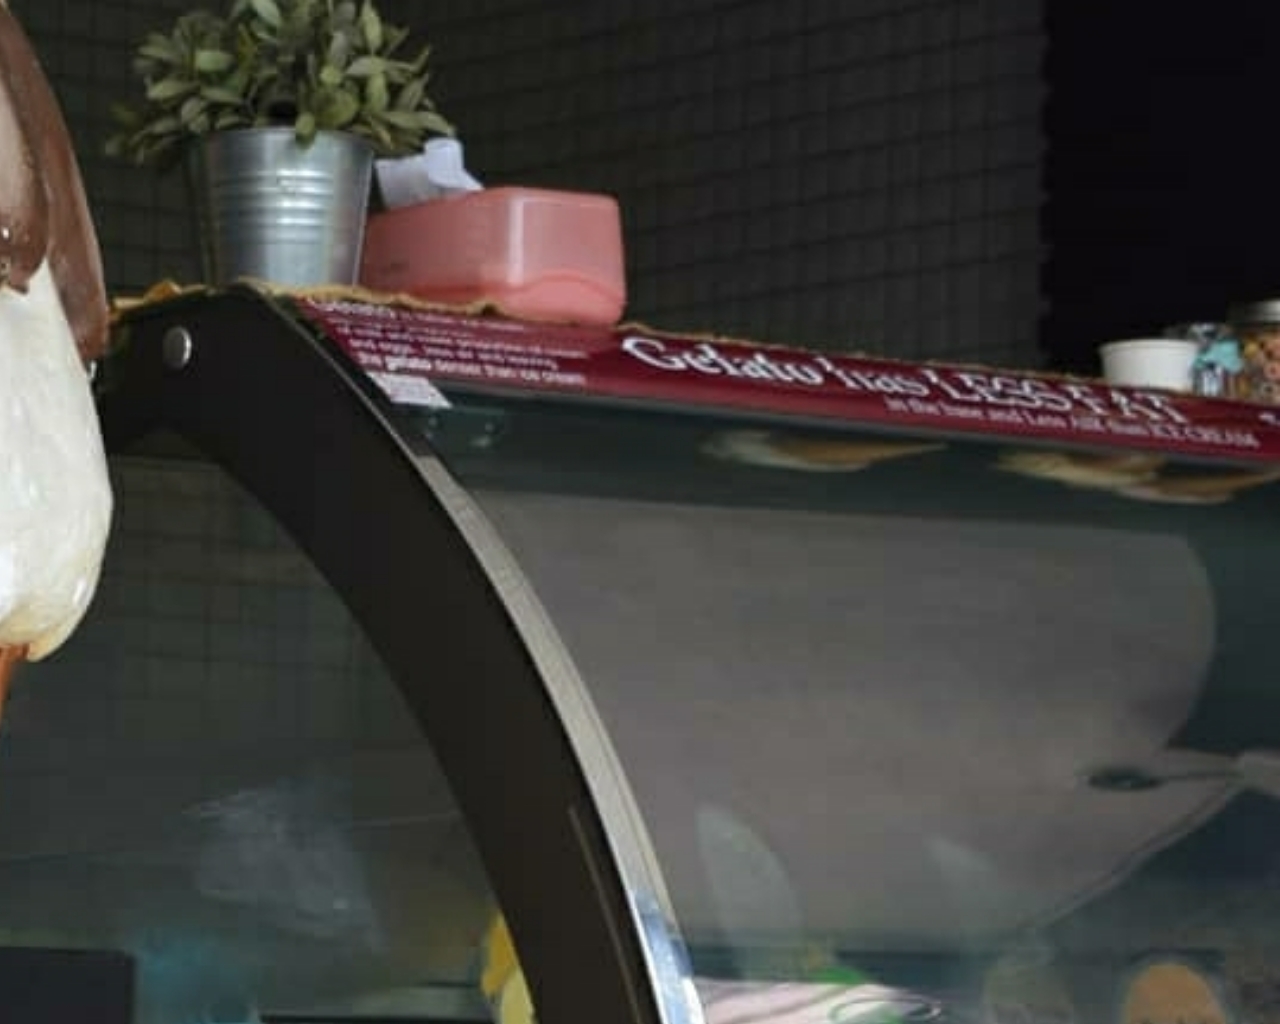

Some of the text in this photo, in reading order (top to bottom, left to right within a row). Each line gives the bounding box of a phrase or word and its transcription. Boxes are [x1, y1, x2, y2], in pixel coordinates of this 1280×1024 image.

[622, 336, 824, 386] Gelato
[922, 368, 1072, 411] LESS
[1062, 383, 1188, 424] FAT
